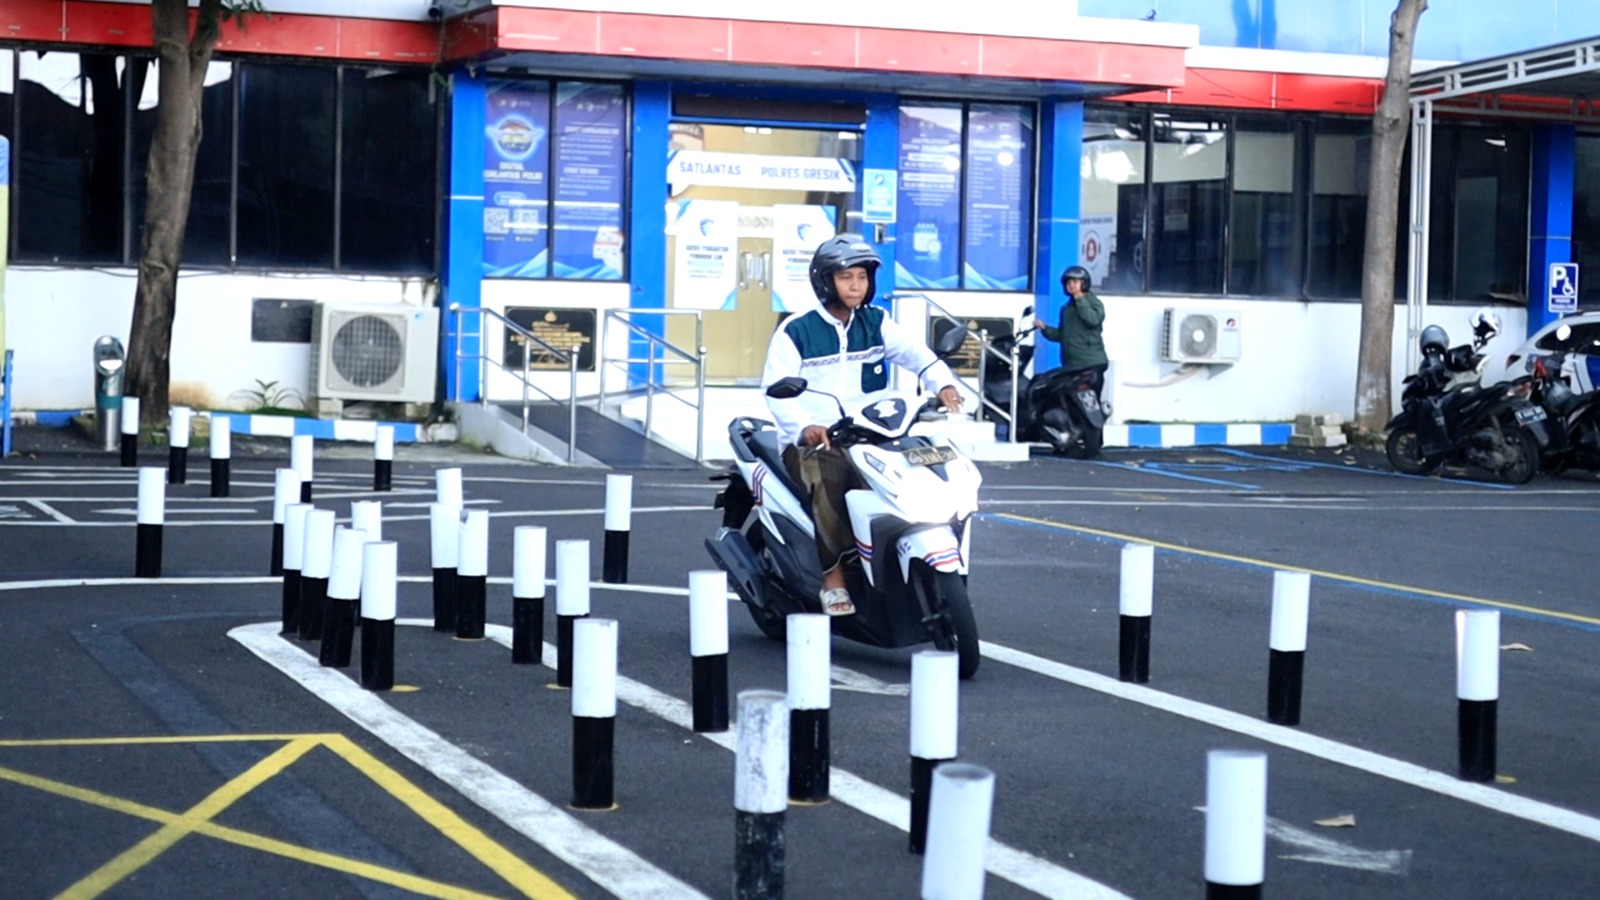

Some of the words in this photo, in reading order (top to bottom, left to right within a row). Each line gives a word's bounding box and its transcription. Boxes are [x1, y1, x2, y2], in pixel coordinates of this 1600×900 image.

[679, 161, 741, 175] SATLANTAS
[761, 166, 799, 179] POLRES
[803, 168, 840, 180] GRESIK
[1552, 266, 1567, 288] P
